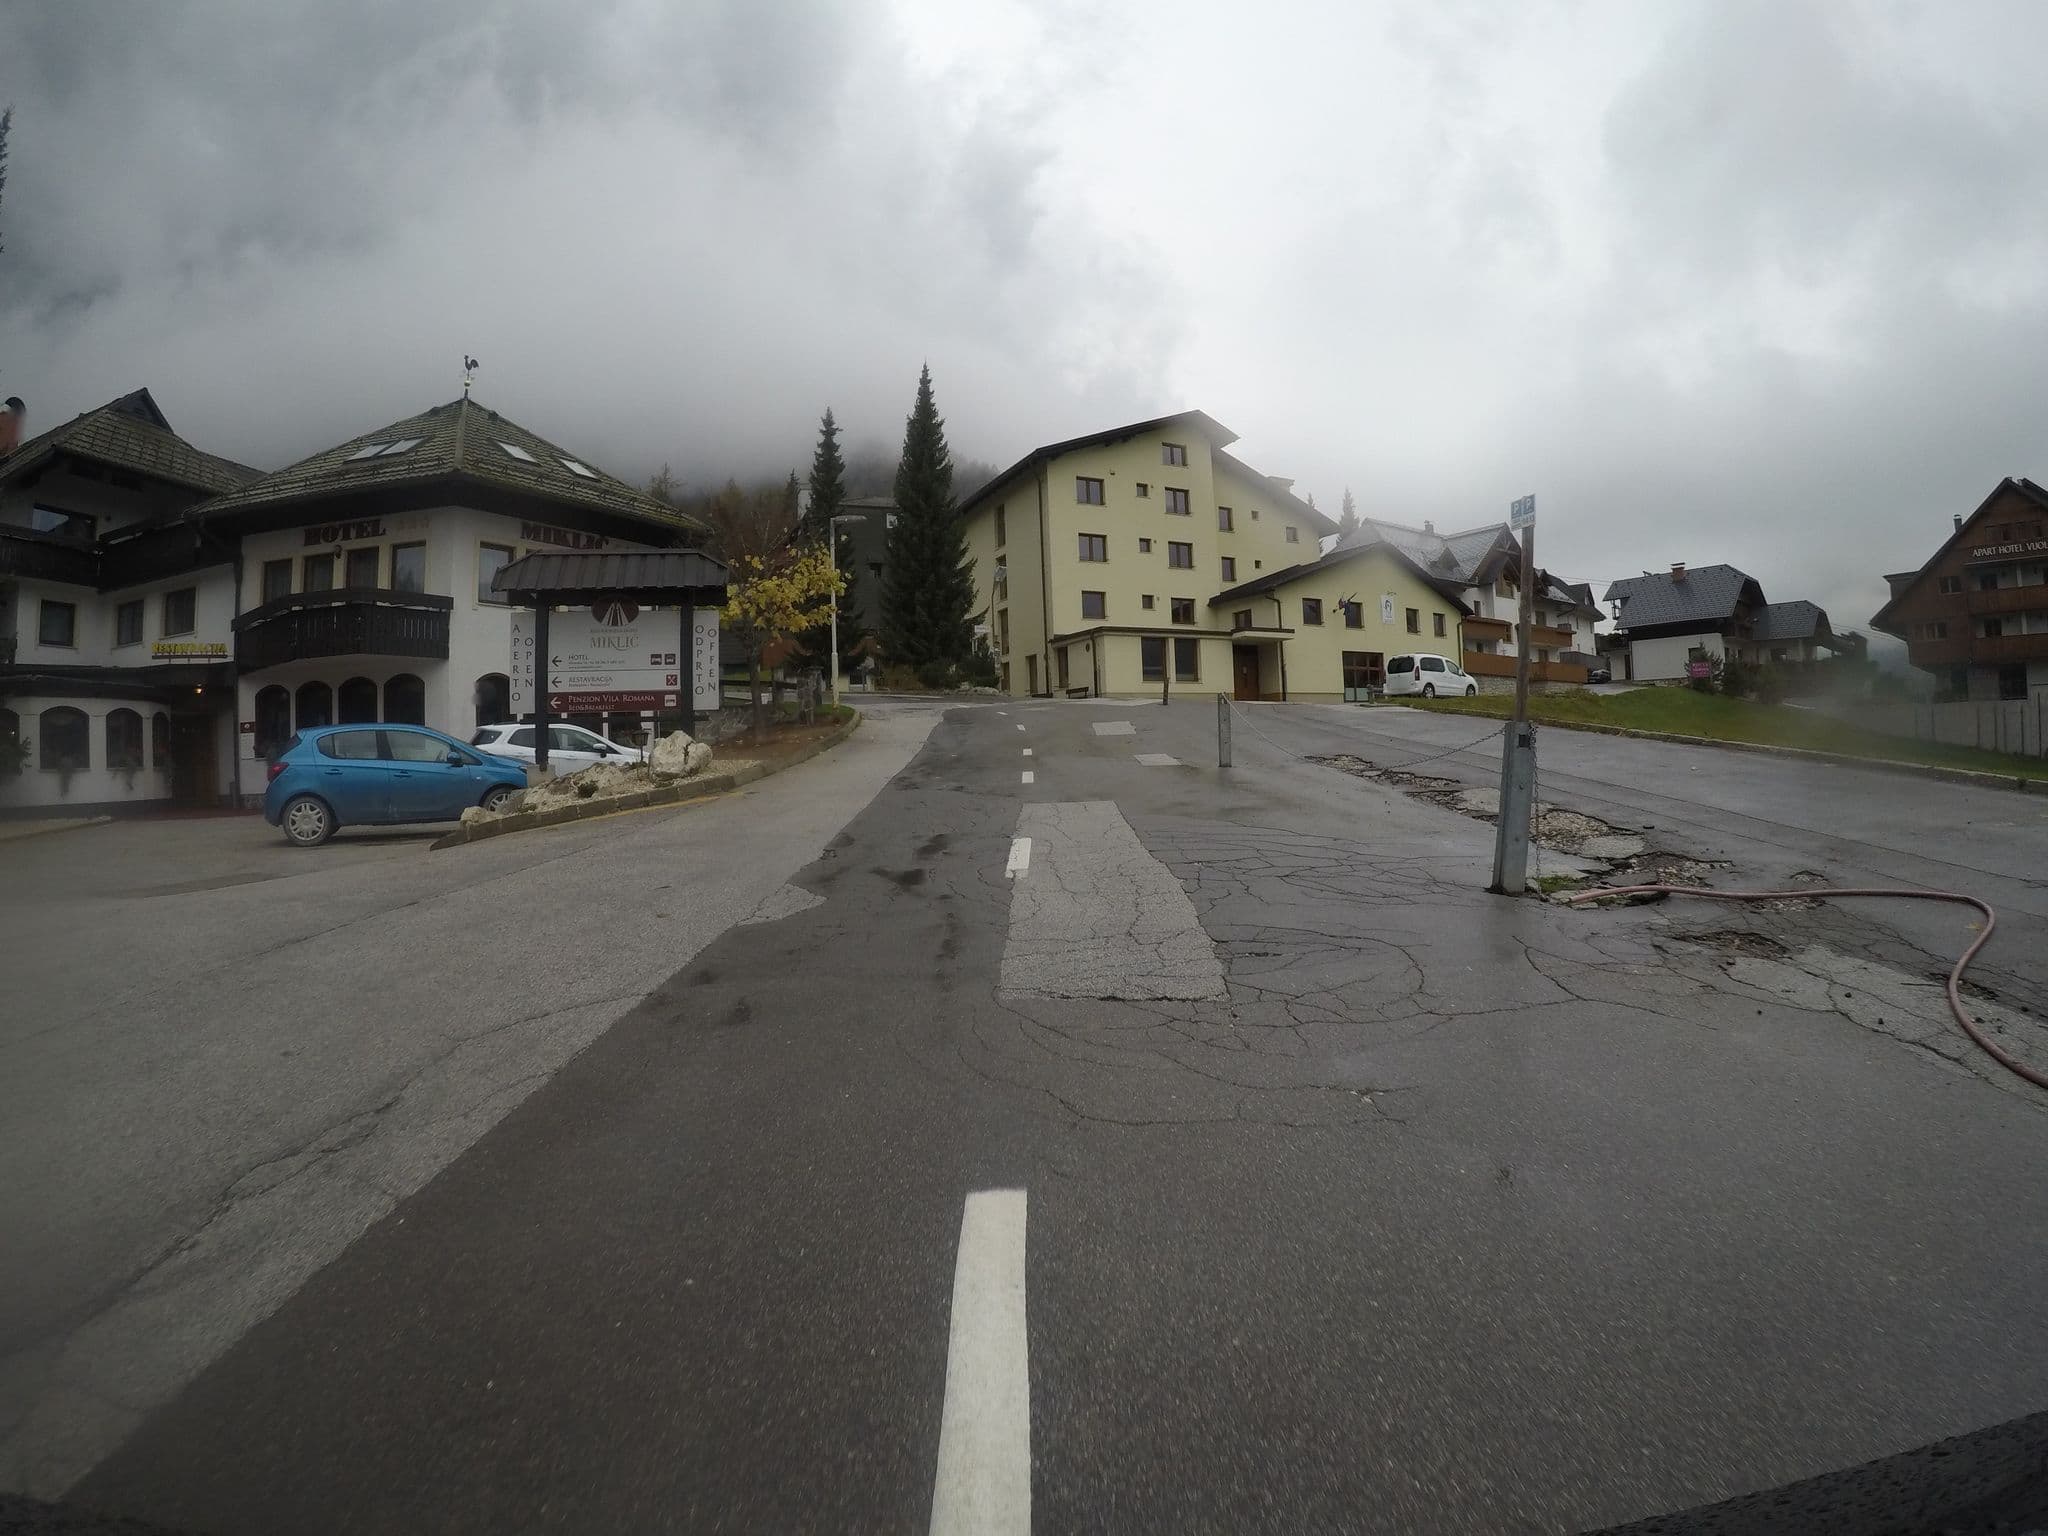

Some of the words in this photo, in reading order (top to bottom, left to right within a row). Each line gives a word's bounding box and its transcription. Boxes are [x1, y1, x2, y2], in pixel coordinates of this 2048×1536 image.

[304, 518, 387, 546] HOTEL
[1972, 546, 1997, 557] APART
[1998, 543, 2024, 554] HOTEL
[511, 624, 521, 702] APERTO
[524, 637, 534, 688] OPEN
[695, 624, 705, 696] ODPRTO
[707, 628, 717, 692] OFFEN
[568, 695, 601, 703] PENZION
[602, 694, 619, 702] VILA
[622, 694, 656, 702] ROMANA
